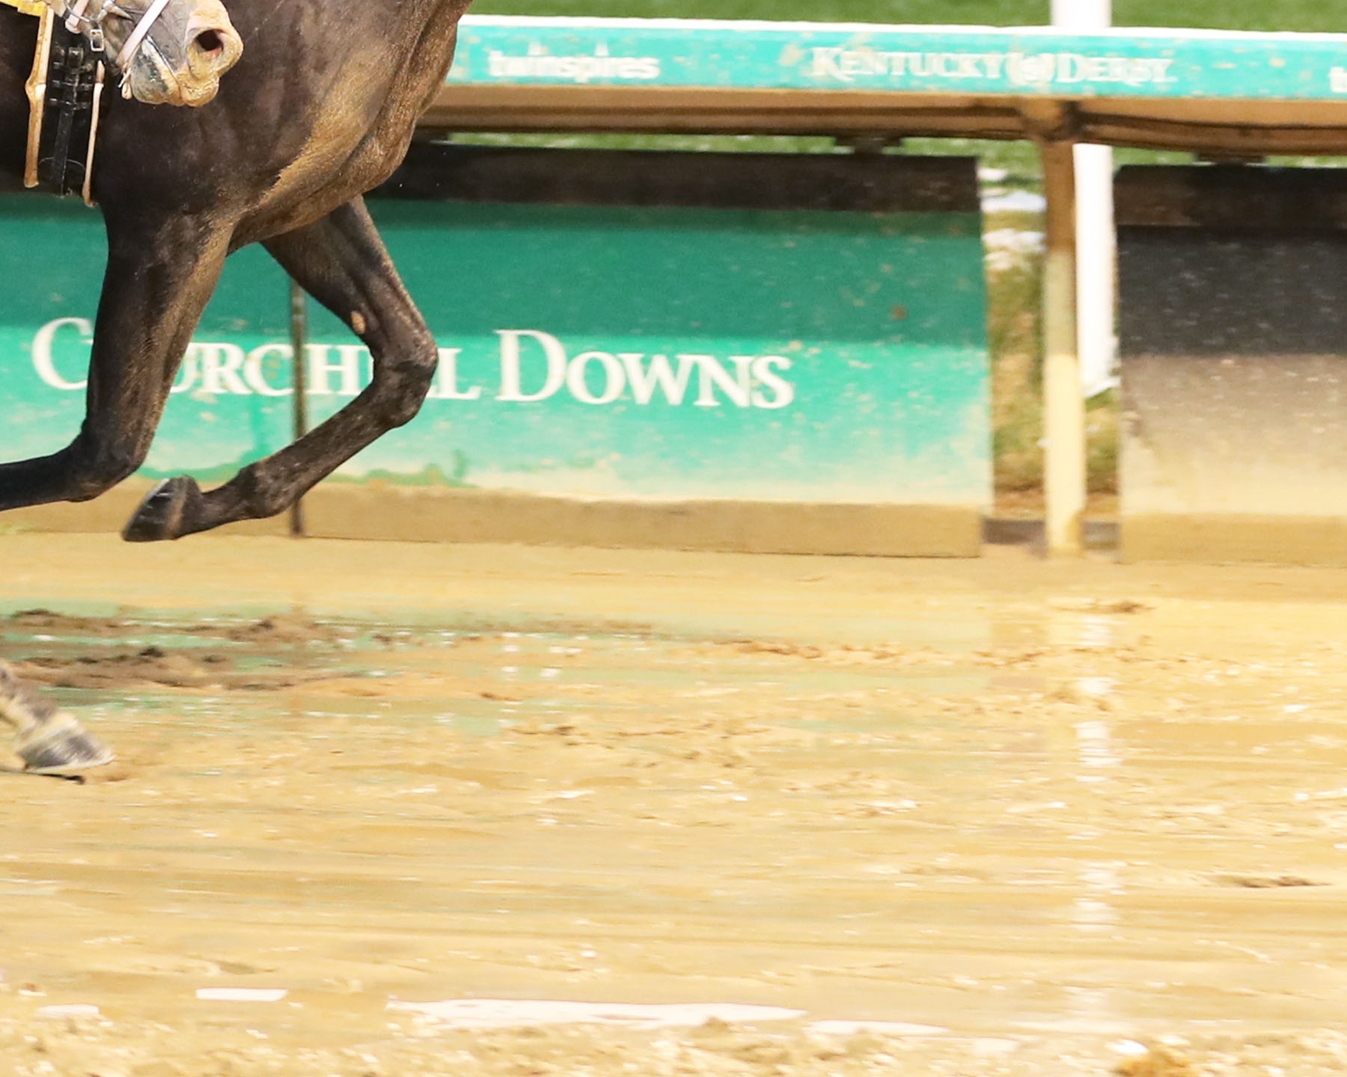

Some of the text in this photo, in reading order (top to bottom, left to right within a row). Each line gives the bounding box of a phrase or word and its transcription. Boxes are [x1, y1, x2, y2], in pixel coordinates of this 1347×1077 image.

[809, 47, 1178, 86] KENTUCKY DERBY
[494, 329, 795, 410] DOWNS
